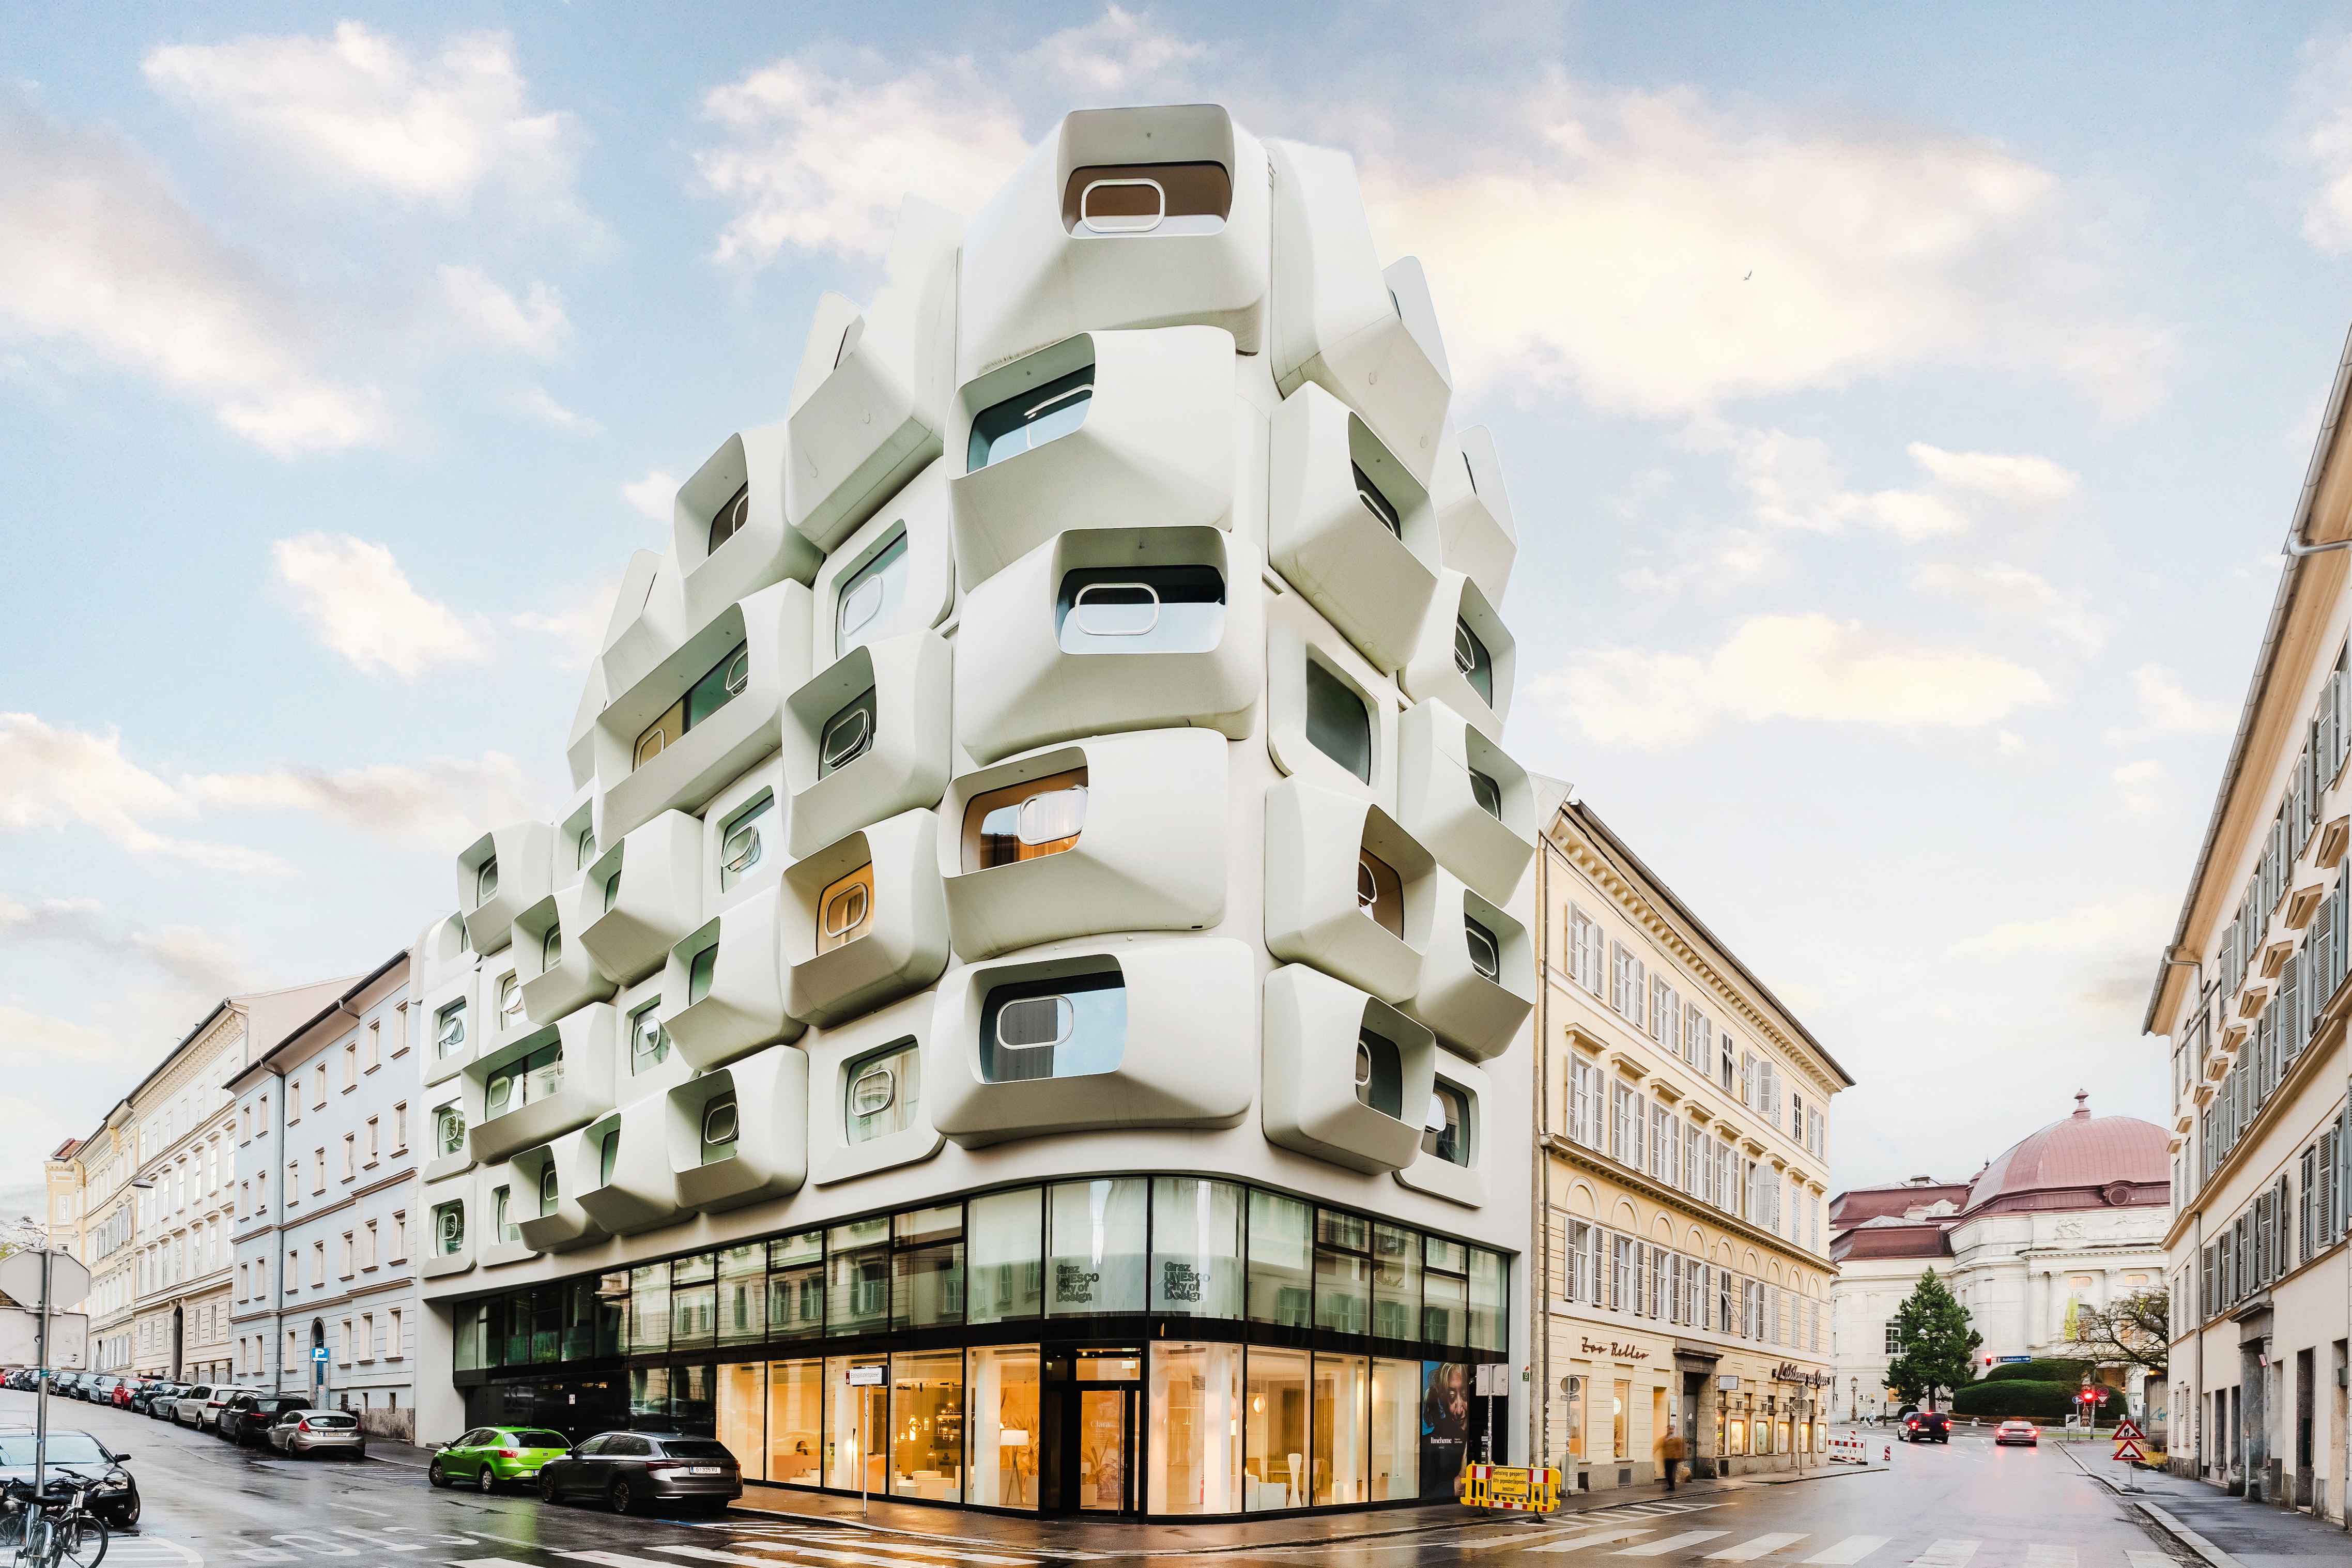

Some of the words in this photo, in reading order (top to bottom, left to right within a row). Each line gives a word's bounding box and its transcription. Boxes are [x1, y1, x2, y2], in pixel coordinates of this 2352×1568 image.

[1056, 1264, 1080, 1274] Graz
[1164, 1262, 1191, 1271] Graz
[1056, 1272, 1099, 1283] UNESCO
[1056, 1283, 1076, 1294] City
[1078, 1282, 1089, 1292] of
[1164, 1280, 1187, 1293] City
[1189, 1282, 1200, 1291] of
[1056, 1292, 1093, 1303] Design
[1164, 1290, 1203, 1302] Design
[315, 1349, 325, 1358] P
